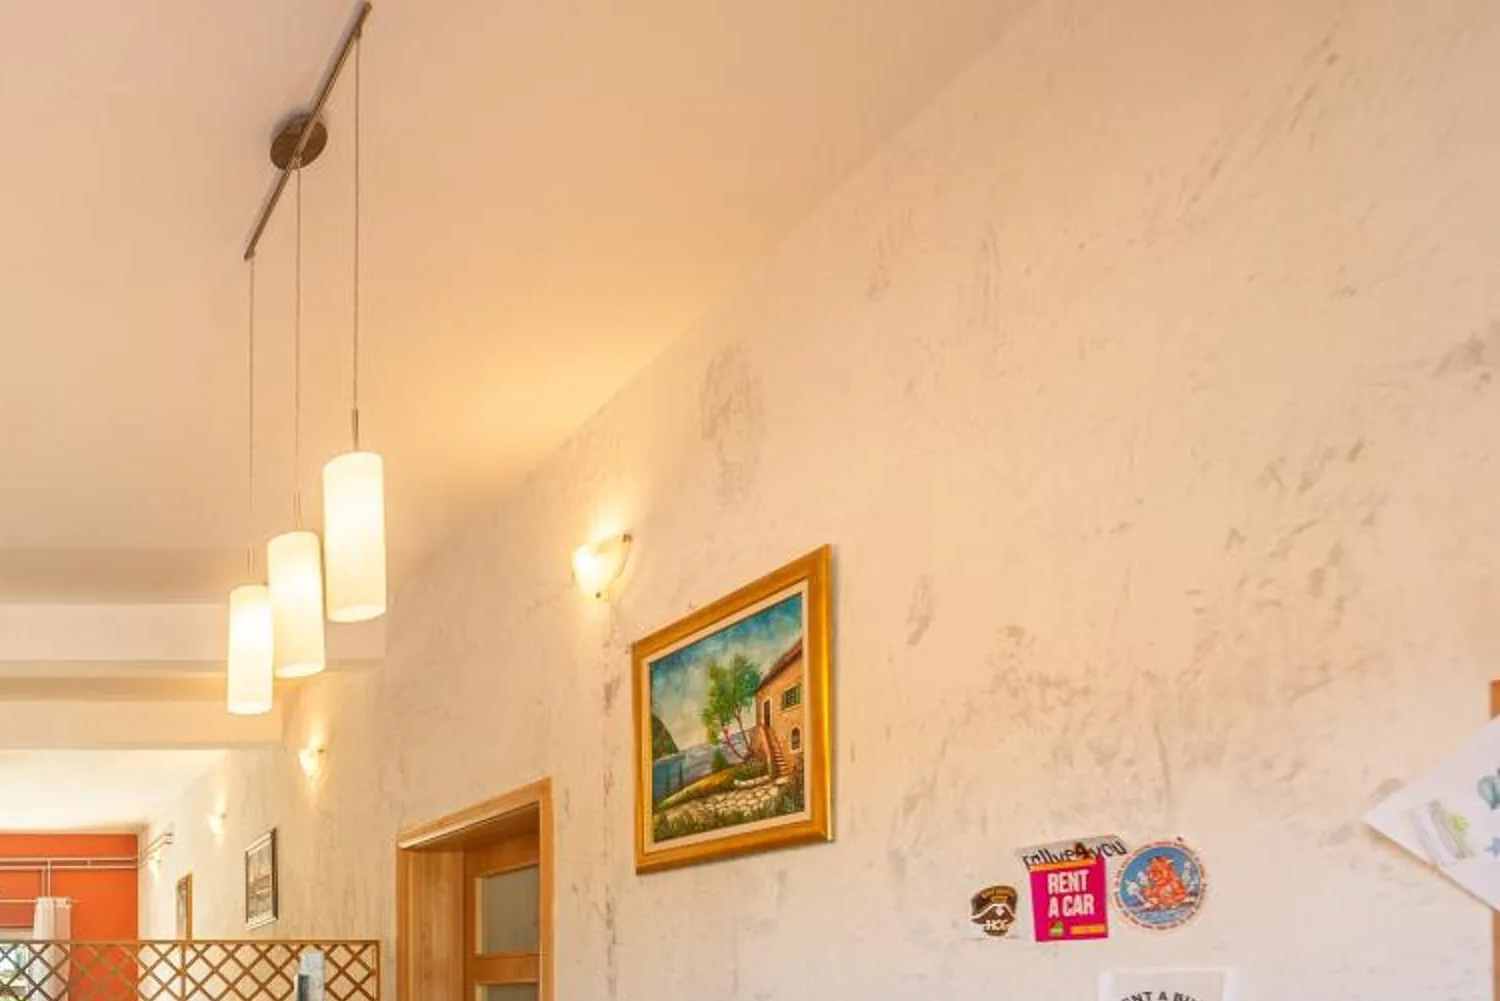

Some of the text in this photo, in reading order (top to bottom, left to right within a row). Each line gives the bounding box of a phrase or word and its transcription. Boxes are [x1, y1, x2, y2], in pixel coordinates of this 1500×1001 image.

[1047, 869, 1090, 894] RENT
[1048, 894, 1095, 918] A CAR
[1158, 991, 1168, 1001] A
